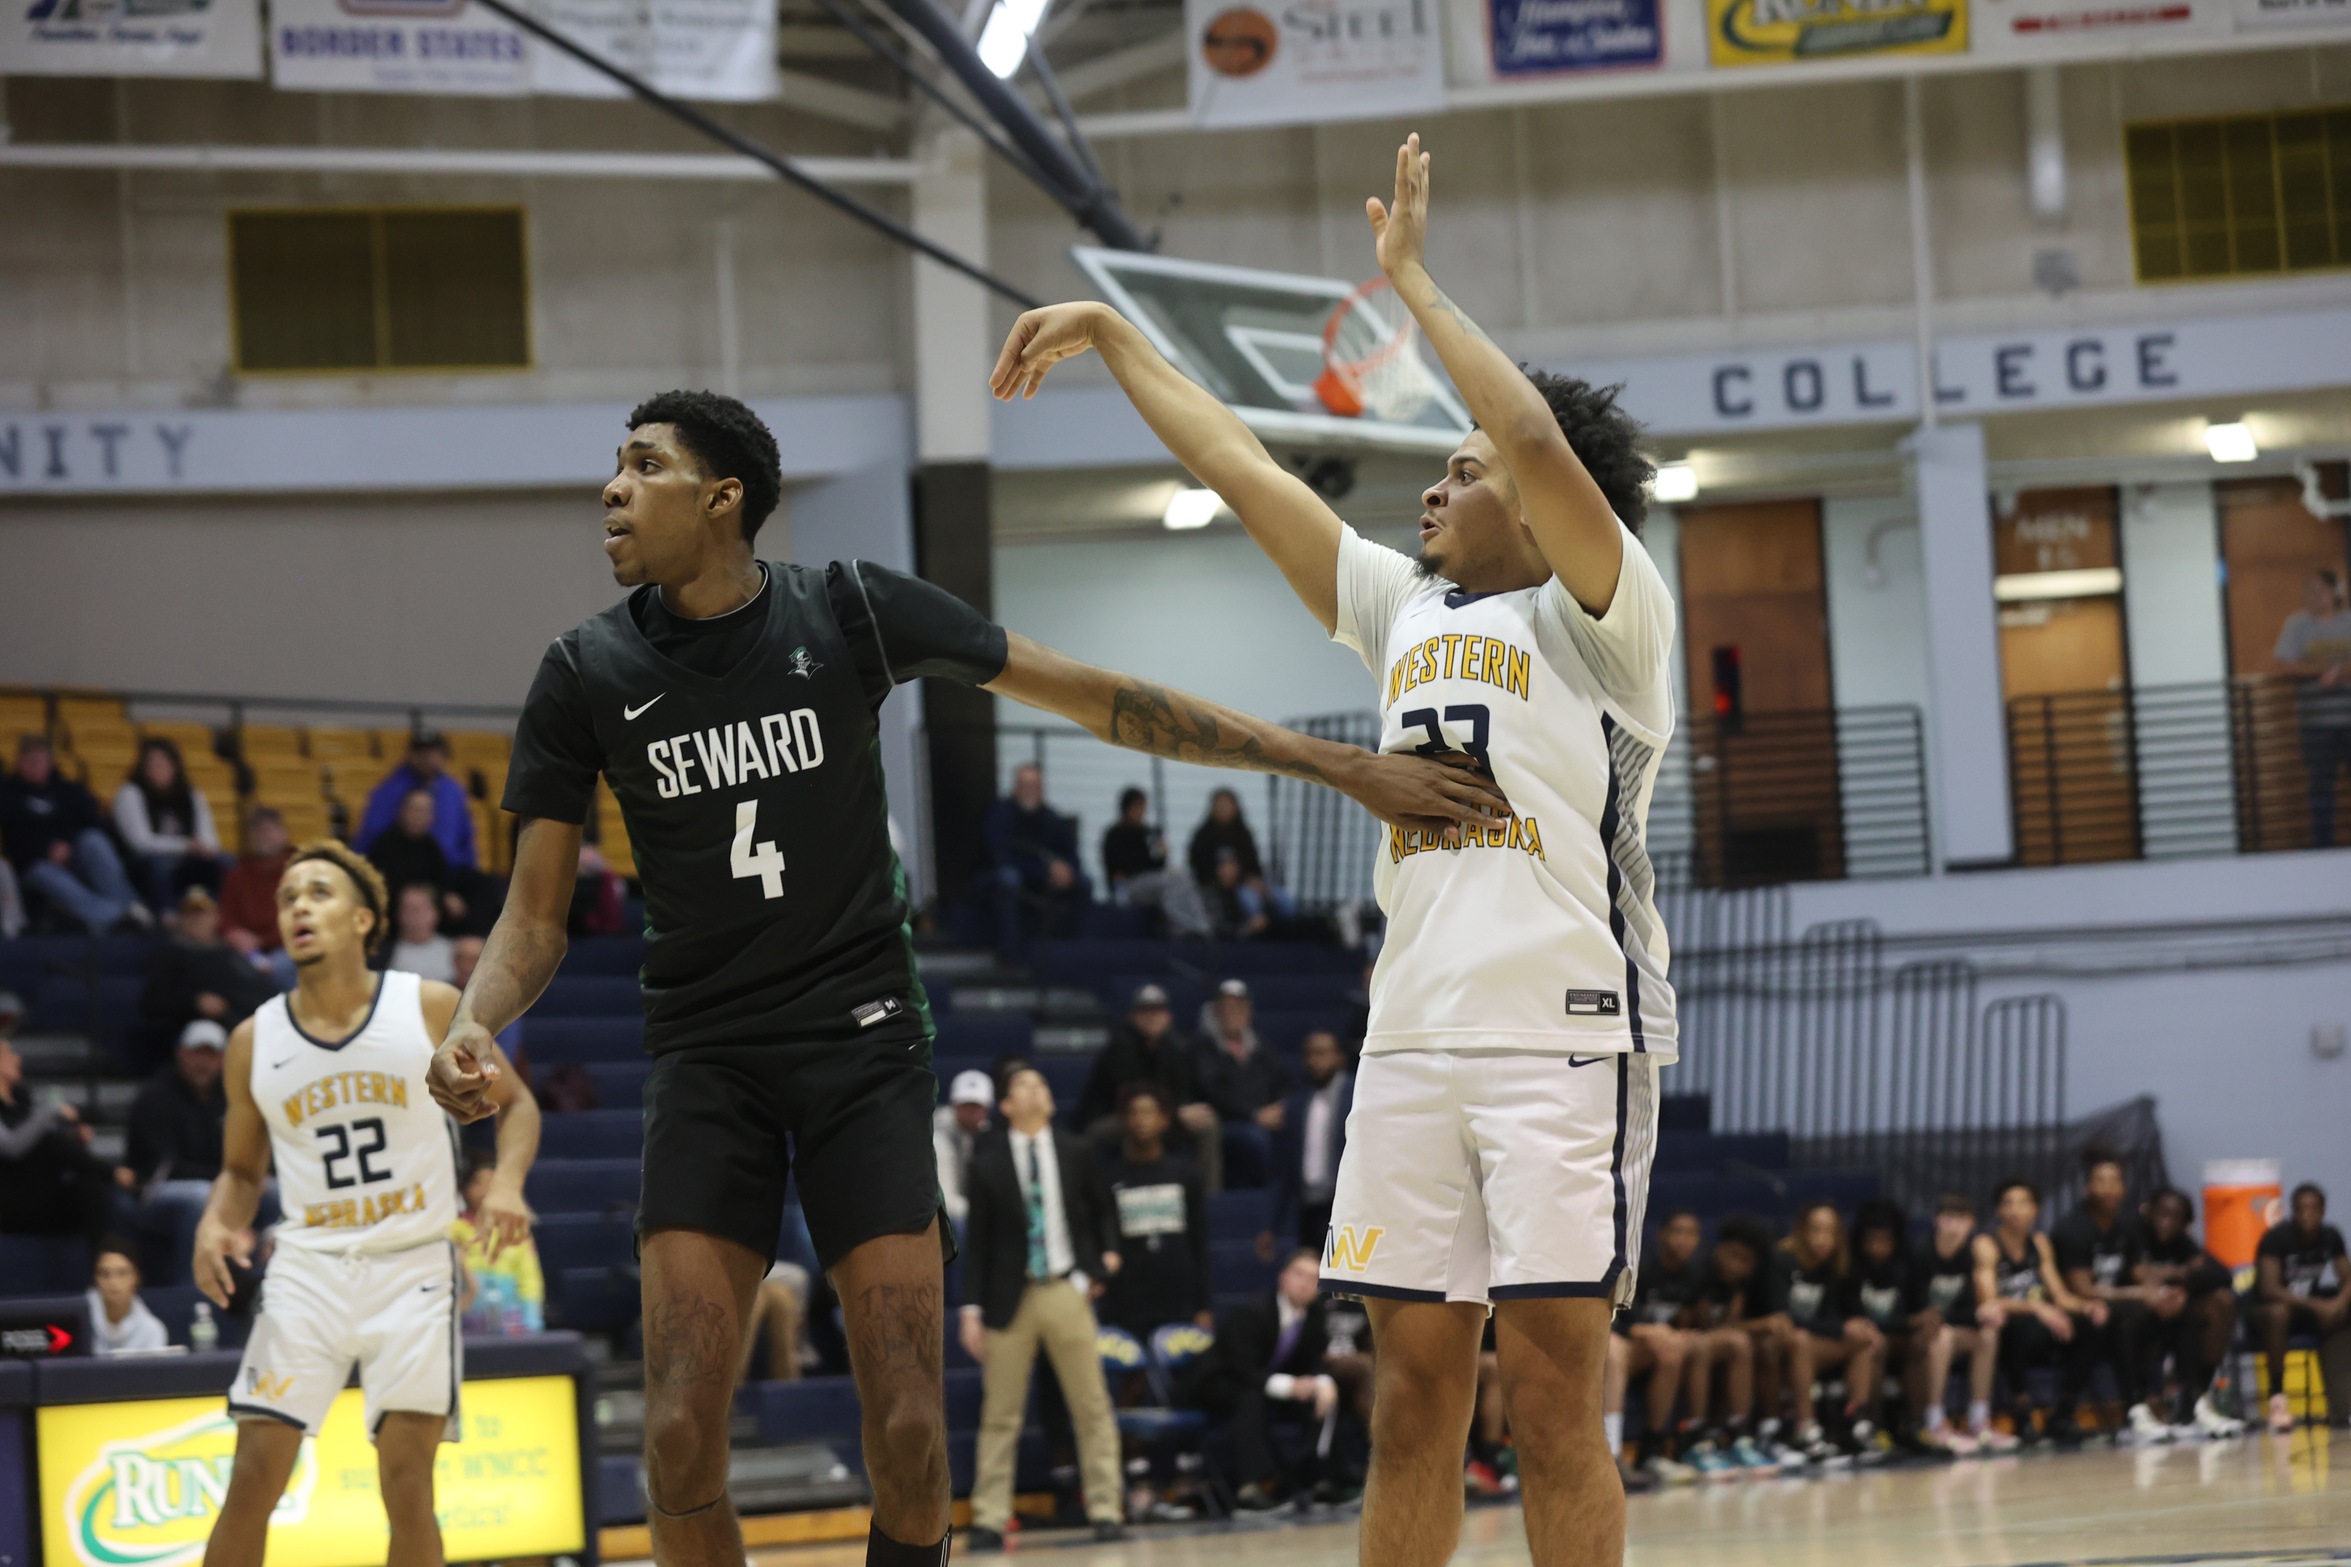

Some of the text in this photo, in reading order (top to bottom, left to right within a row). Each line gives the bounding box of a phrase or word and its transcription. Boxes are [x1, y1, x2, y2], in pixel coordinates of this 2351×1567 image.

[283, 27, 524, 61] BORDER STATES
[1711, 333, 2180, 419] COLLEGE
[1387, 633, 1531, 711] WESTERN
[646, 707, 825, 799] SEWARD
[729, 799, 786, 900] 4
[1602, 997, 1616, 1009] XL
[282, 1070, 408, 1128] WESTERN
[315, 1115, 393, 1190] 22
[304, 1182, 427, 1229] NEBRASKA
[107, 1451, 298, 1528] RUN
